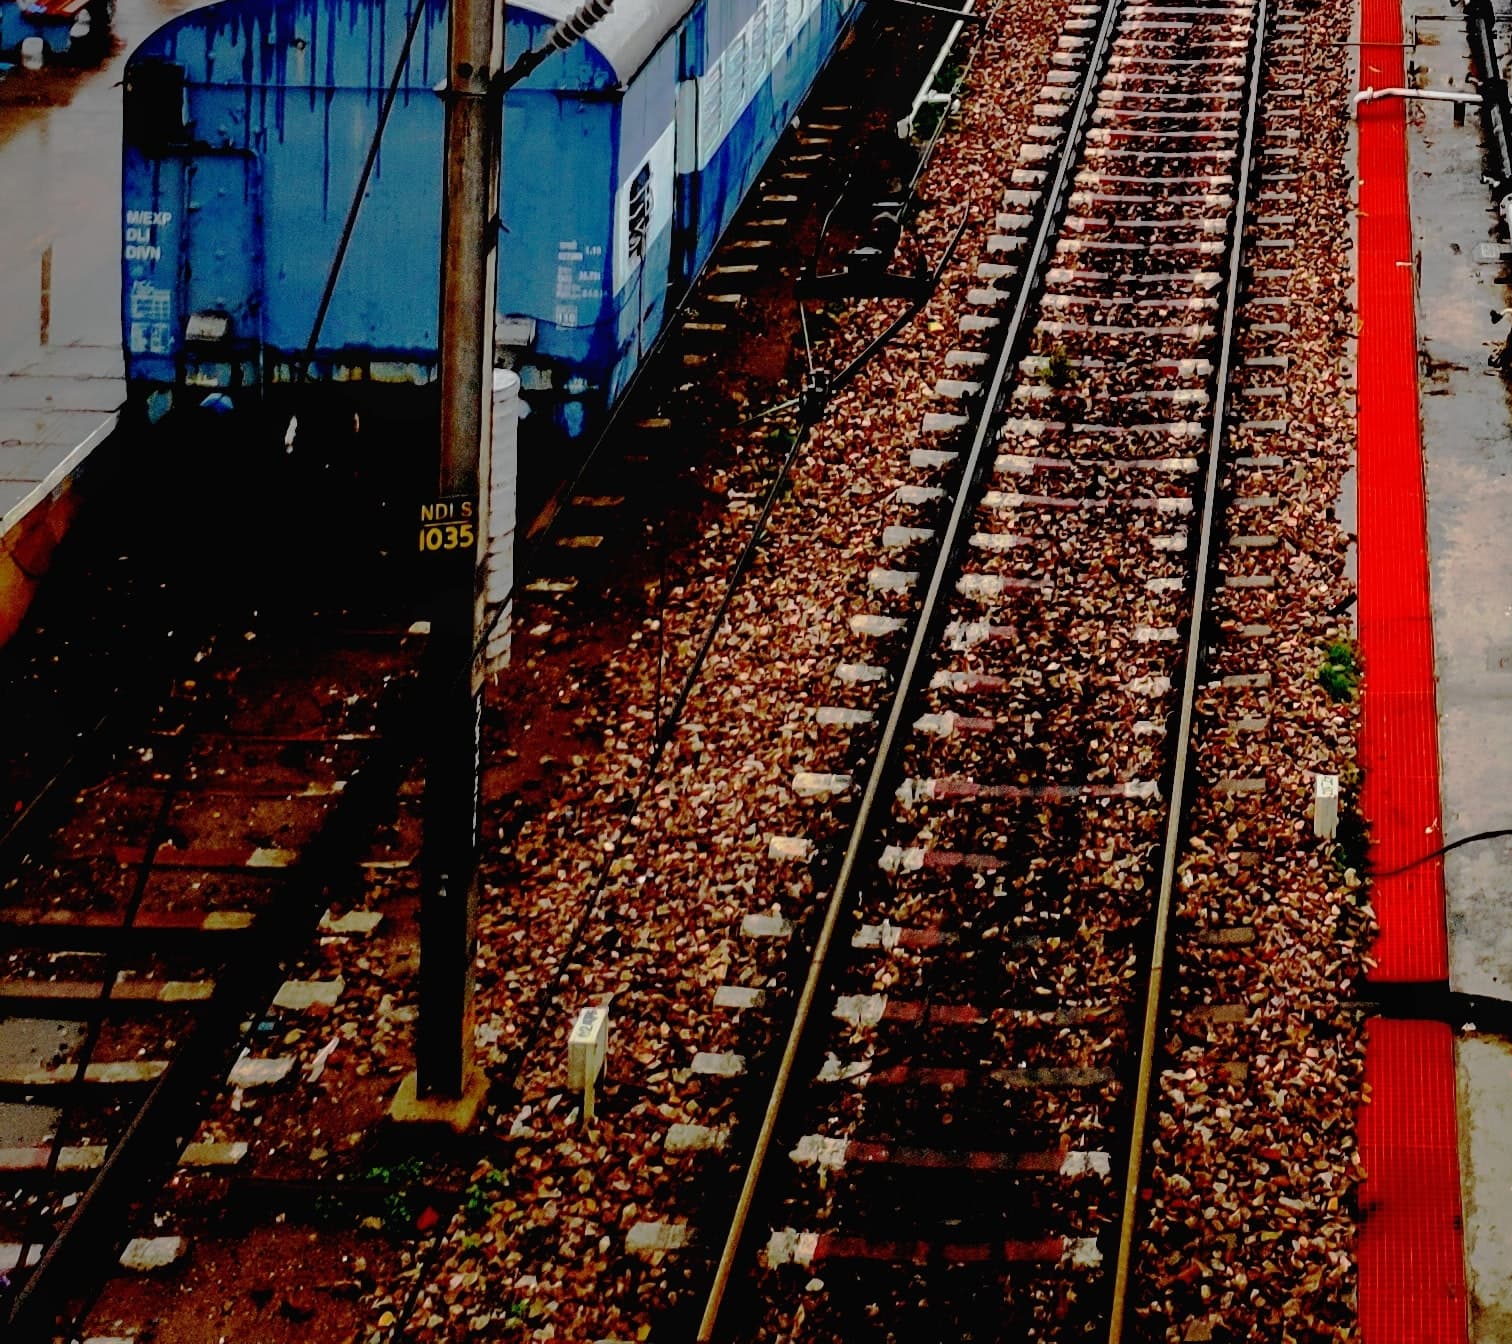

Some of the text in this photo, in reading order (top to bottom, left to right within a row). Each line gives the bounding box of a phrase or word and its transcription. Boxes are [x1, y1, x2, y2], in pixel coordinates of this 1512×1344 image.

[126, 210, 172, 225] M/EXP
[126, 245, 161, 261] DIVN
[419, 524, 474, 552] 1035
